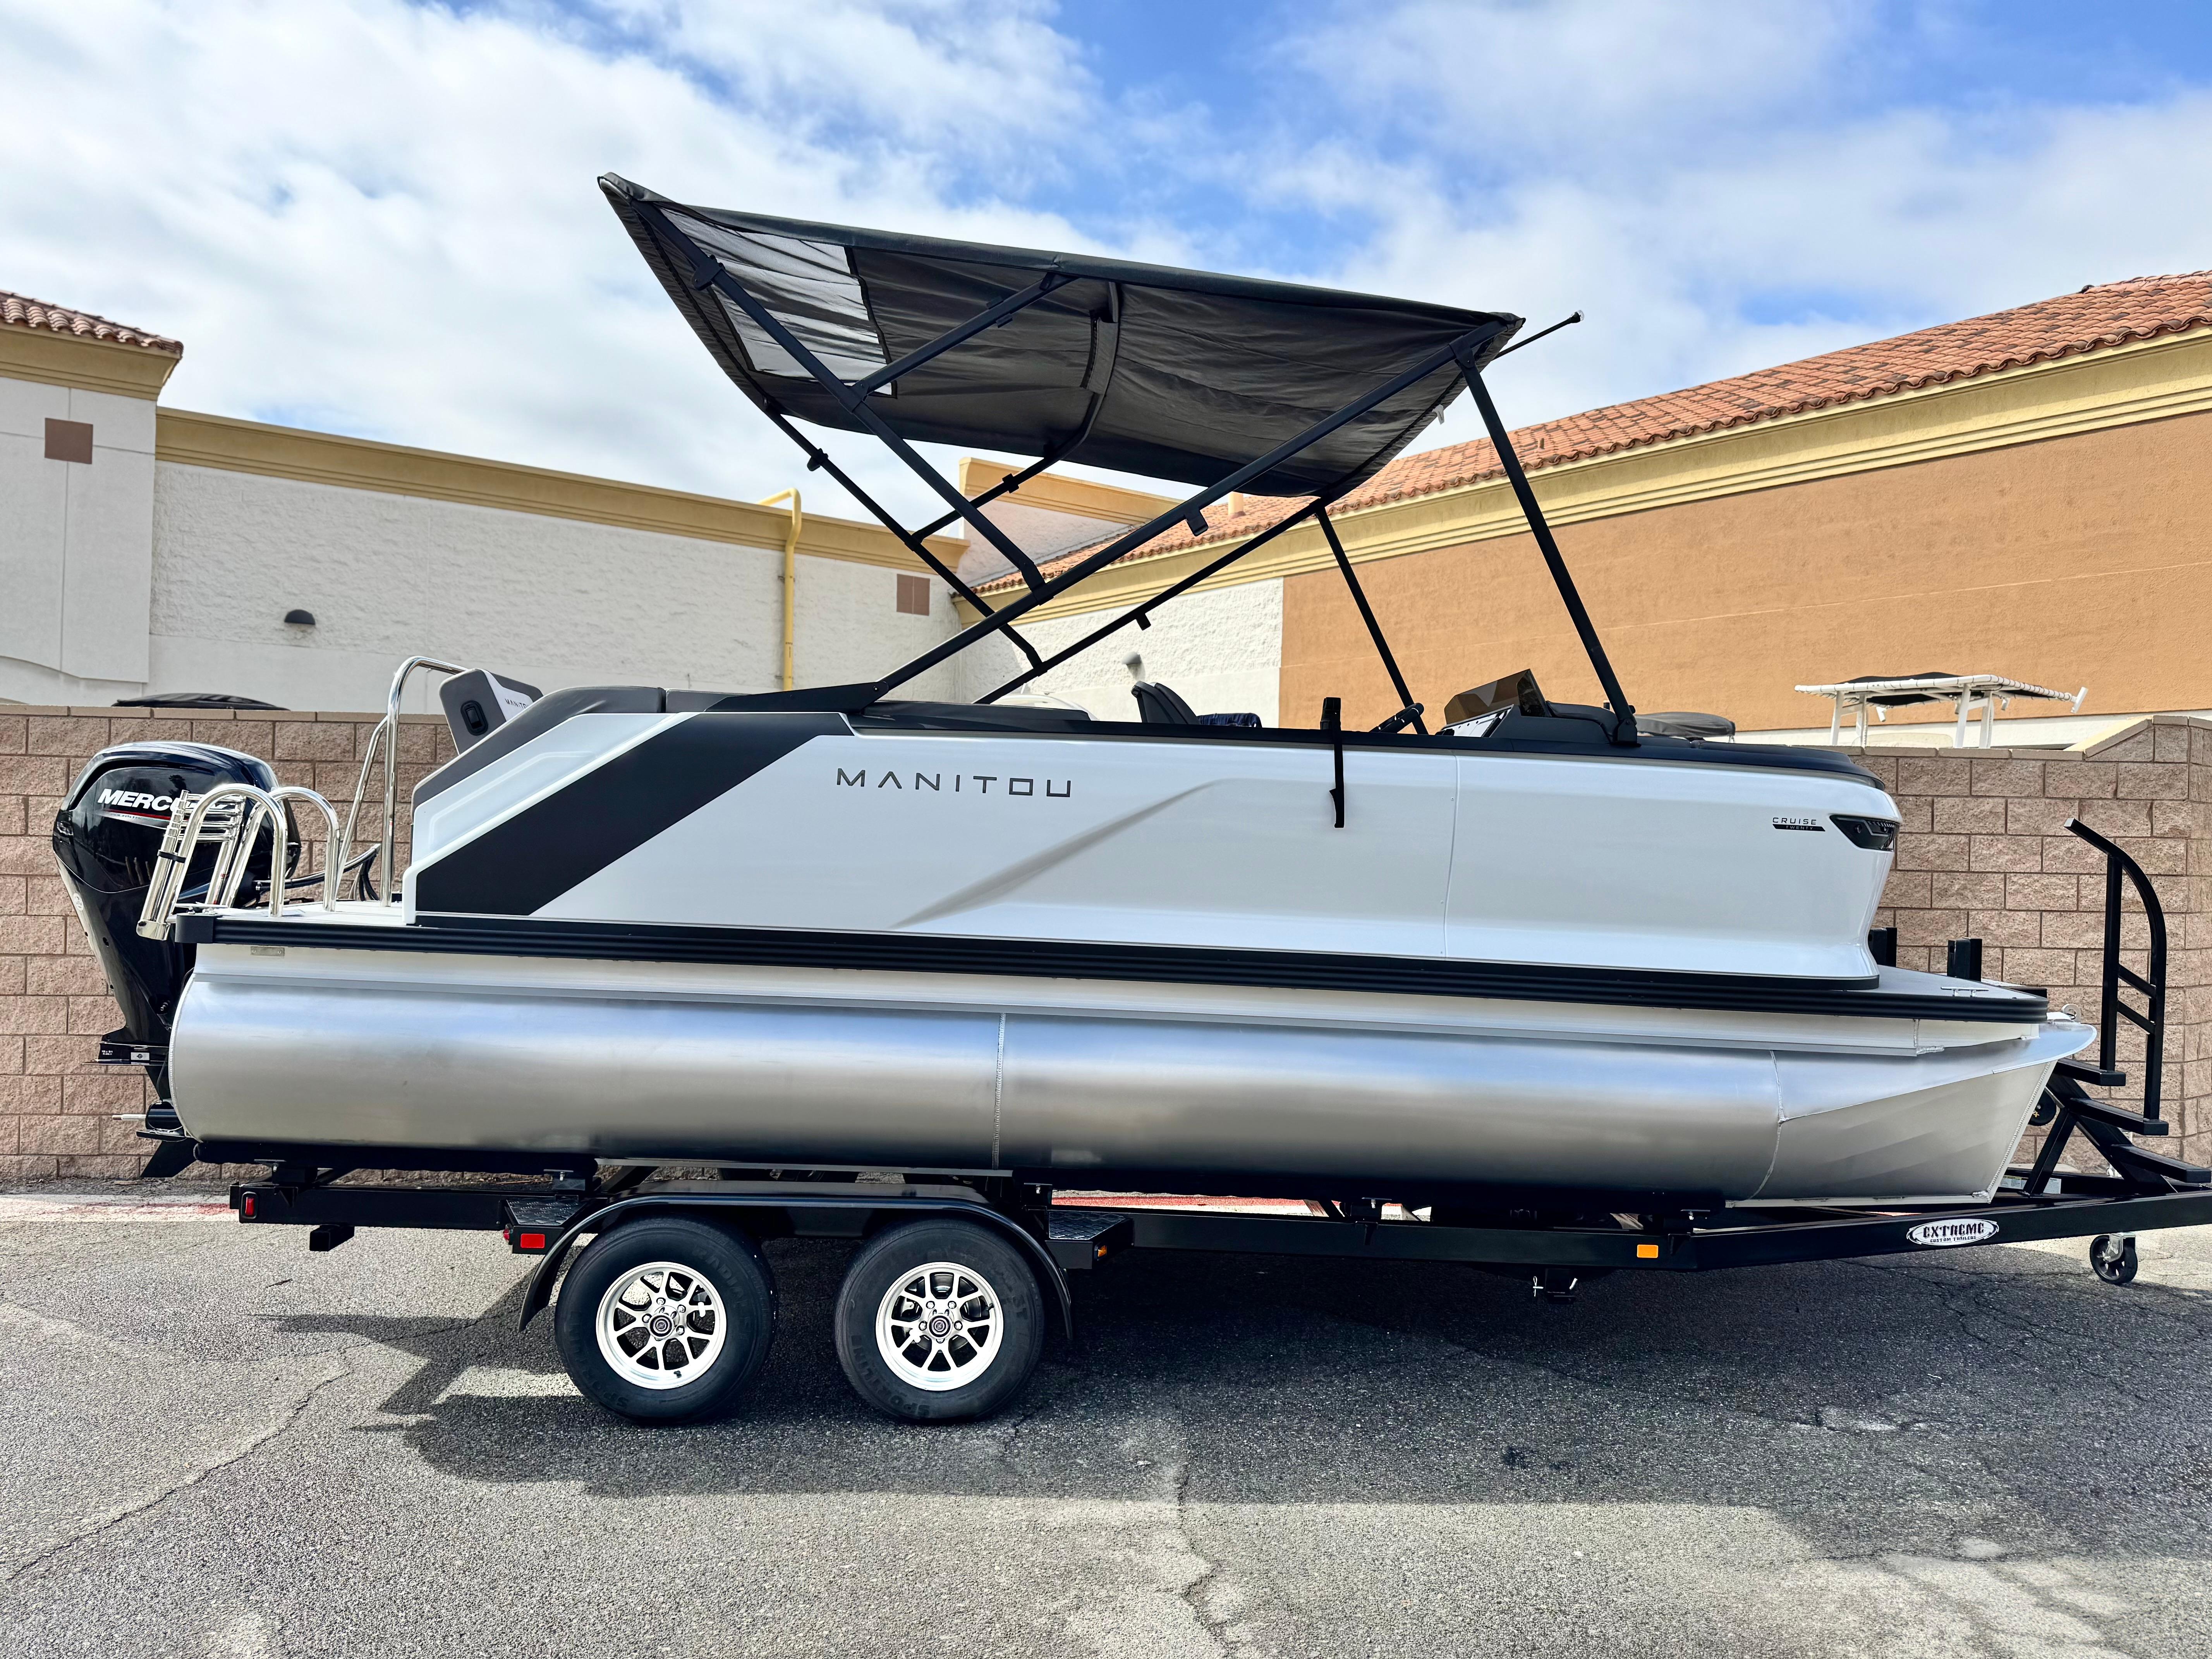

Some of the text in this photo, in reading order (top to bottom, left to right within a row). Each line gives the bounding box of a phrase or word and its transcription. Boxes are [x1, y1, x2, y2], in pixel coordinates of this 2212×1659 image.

[505, 698, 528, 709] MANITO
[836, 768, 1071, 797] MANITOU
[97, 788, 228, 812] MERC
[1923, 1222, 1984, 1238] EXTREME
